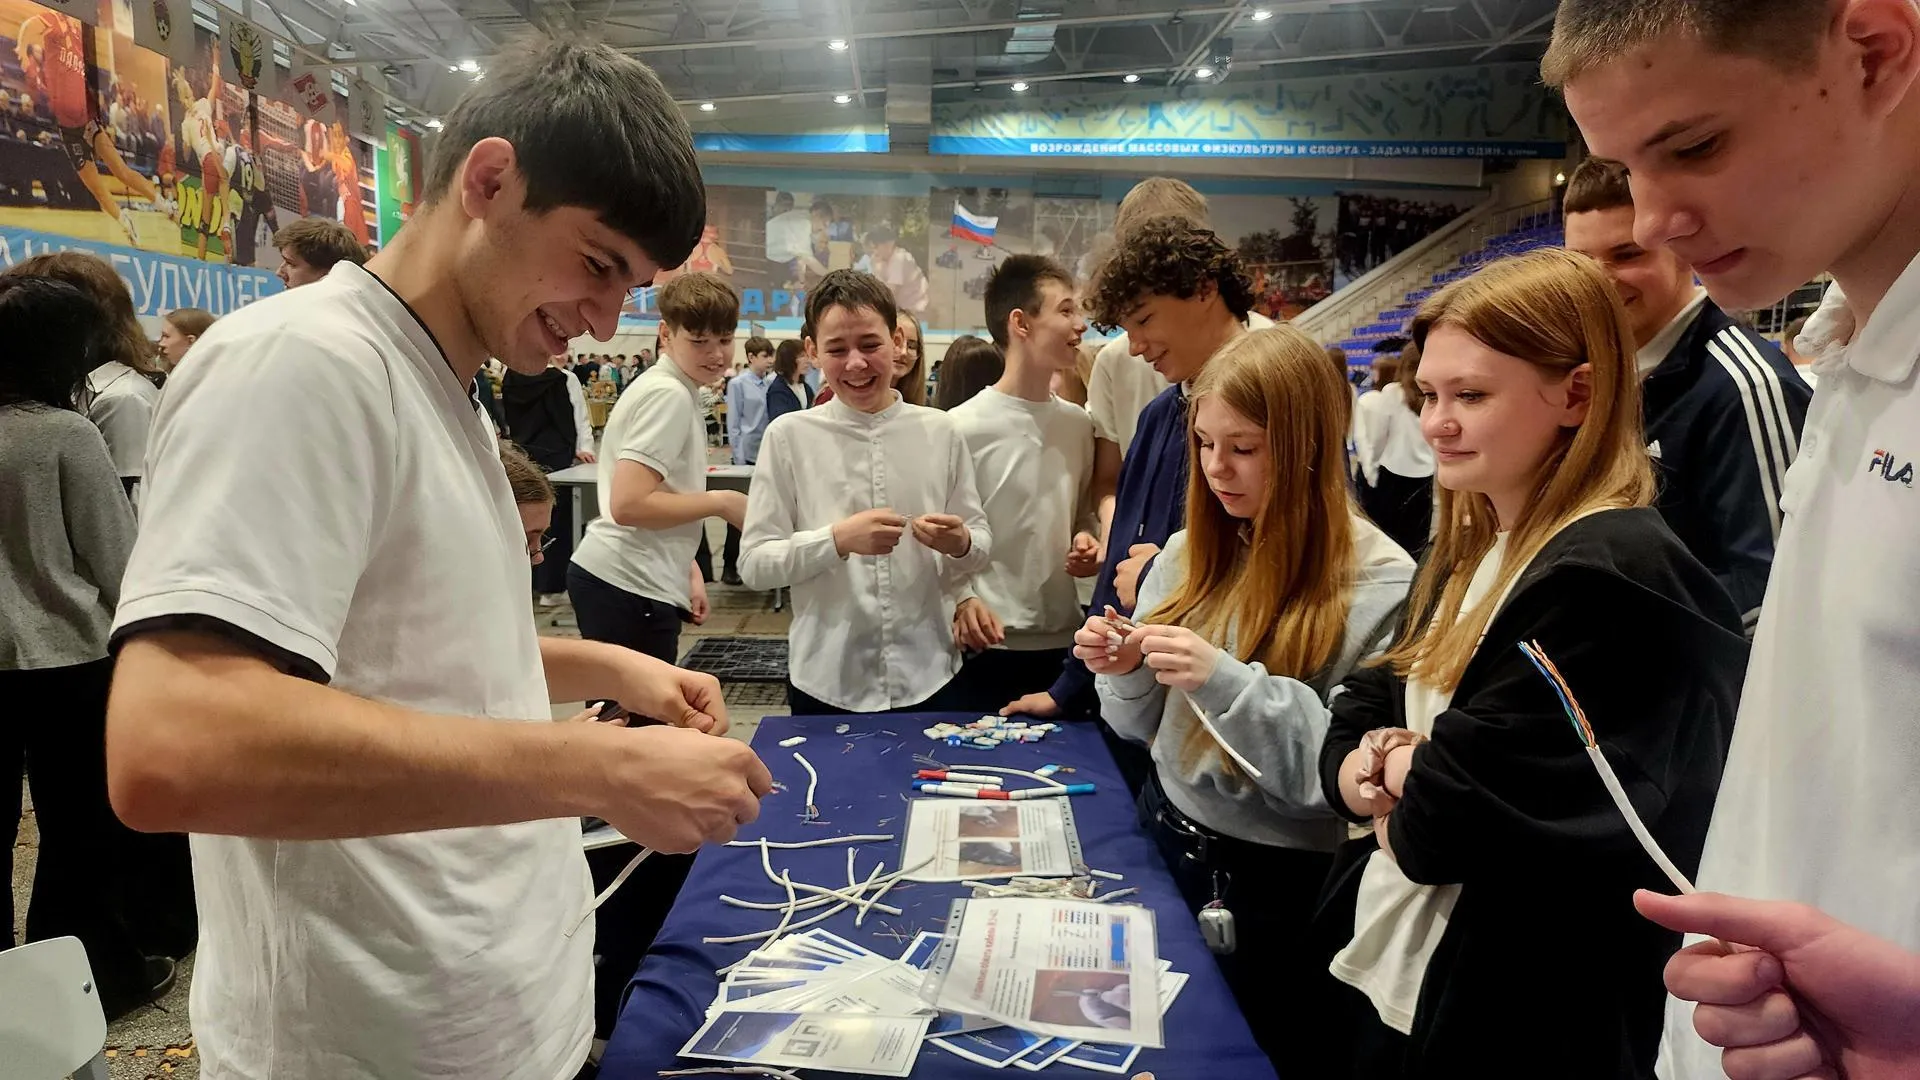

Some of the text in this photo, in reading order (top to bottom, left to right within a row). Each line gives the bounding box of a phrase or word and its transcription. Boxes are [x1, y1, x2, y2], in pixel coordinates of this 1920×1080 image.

[1030, 143, 1124, 154] ВОЗРОЖДЕНИЕ
[1128, 143, 1200, 153] МАССОВЫХ
[1202, 143, 1295, 155] ФИЗКУЛЬТУРЫ
[1297, 144, 1307, 154] И
[1309, 144, 1359, 155] СПОРТА
[1369, 146, 1418, 157] ЗАДАЧА
[1422, 146, 1463, 156] НОМЕР
[1868, 449, 1913, 484] FILA
